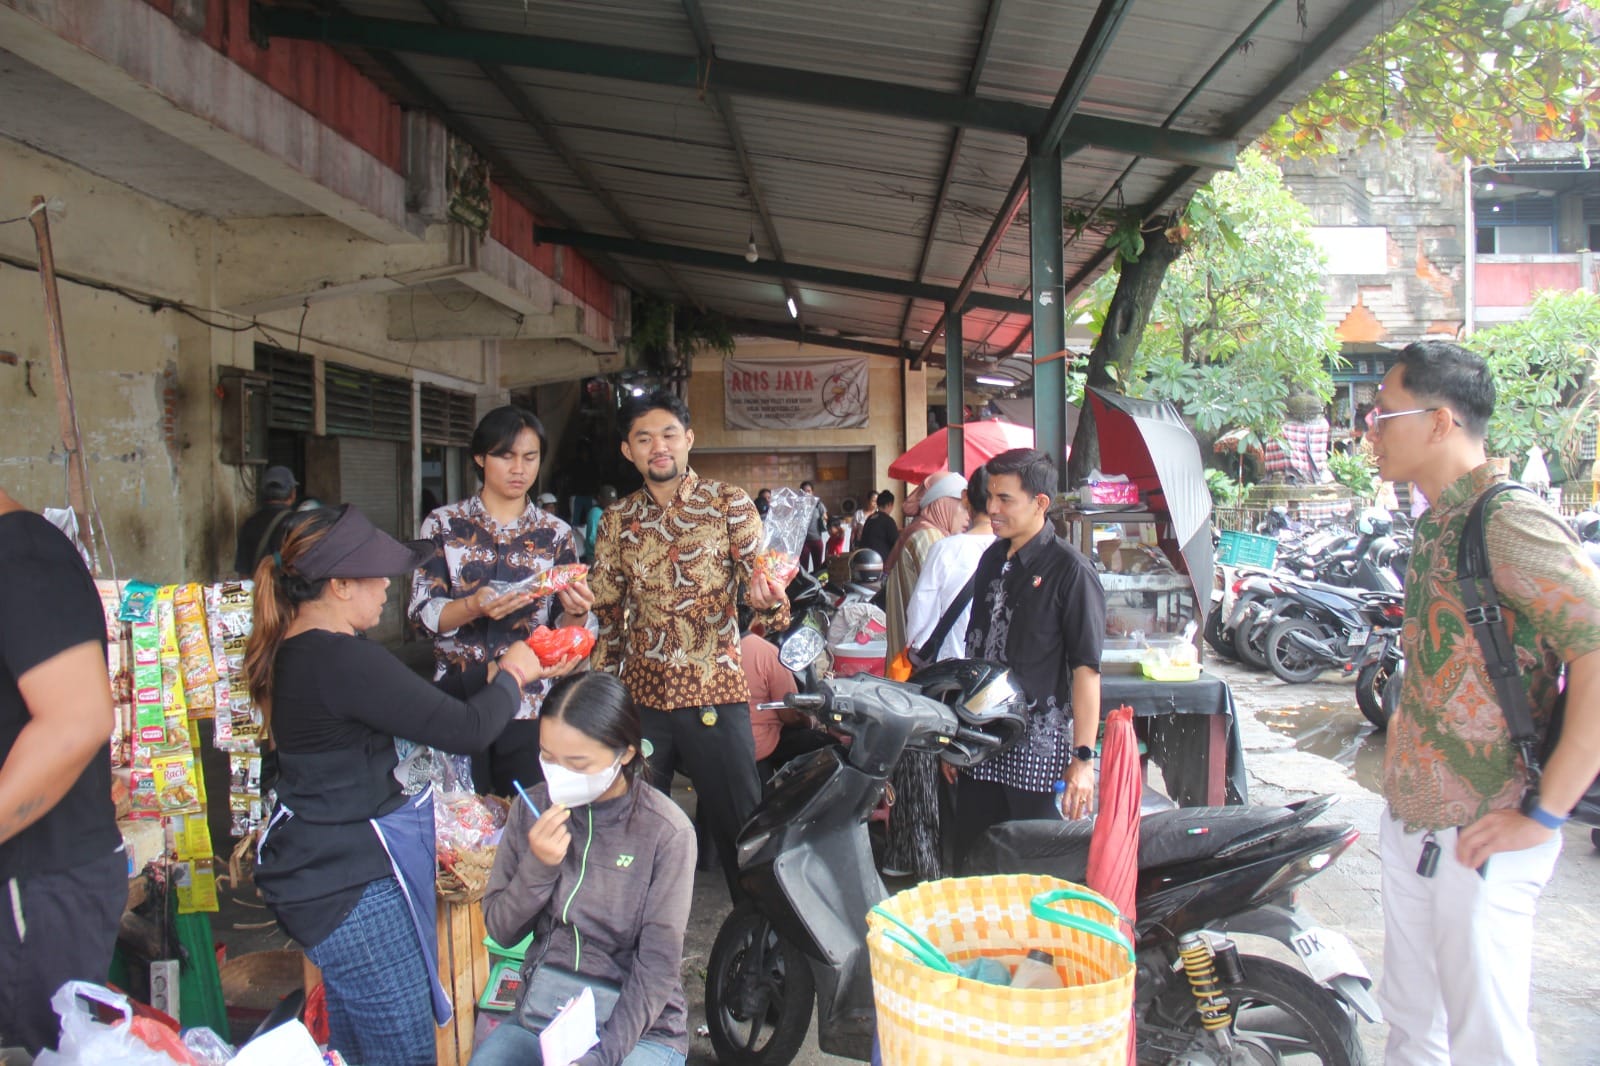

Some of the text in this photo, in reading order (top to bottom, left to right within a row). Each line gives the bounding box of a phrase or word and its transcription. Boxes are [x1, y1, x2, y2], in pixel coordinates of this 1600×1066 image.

[732, 370, 814, 392] ARIS JAYA
[163, 767, 187, 781] Racik
[1295, 933, 1326, 956] DK
